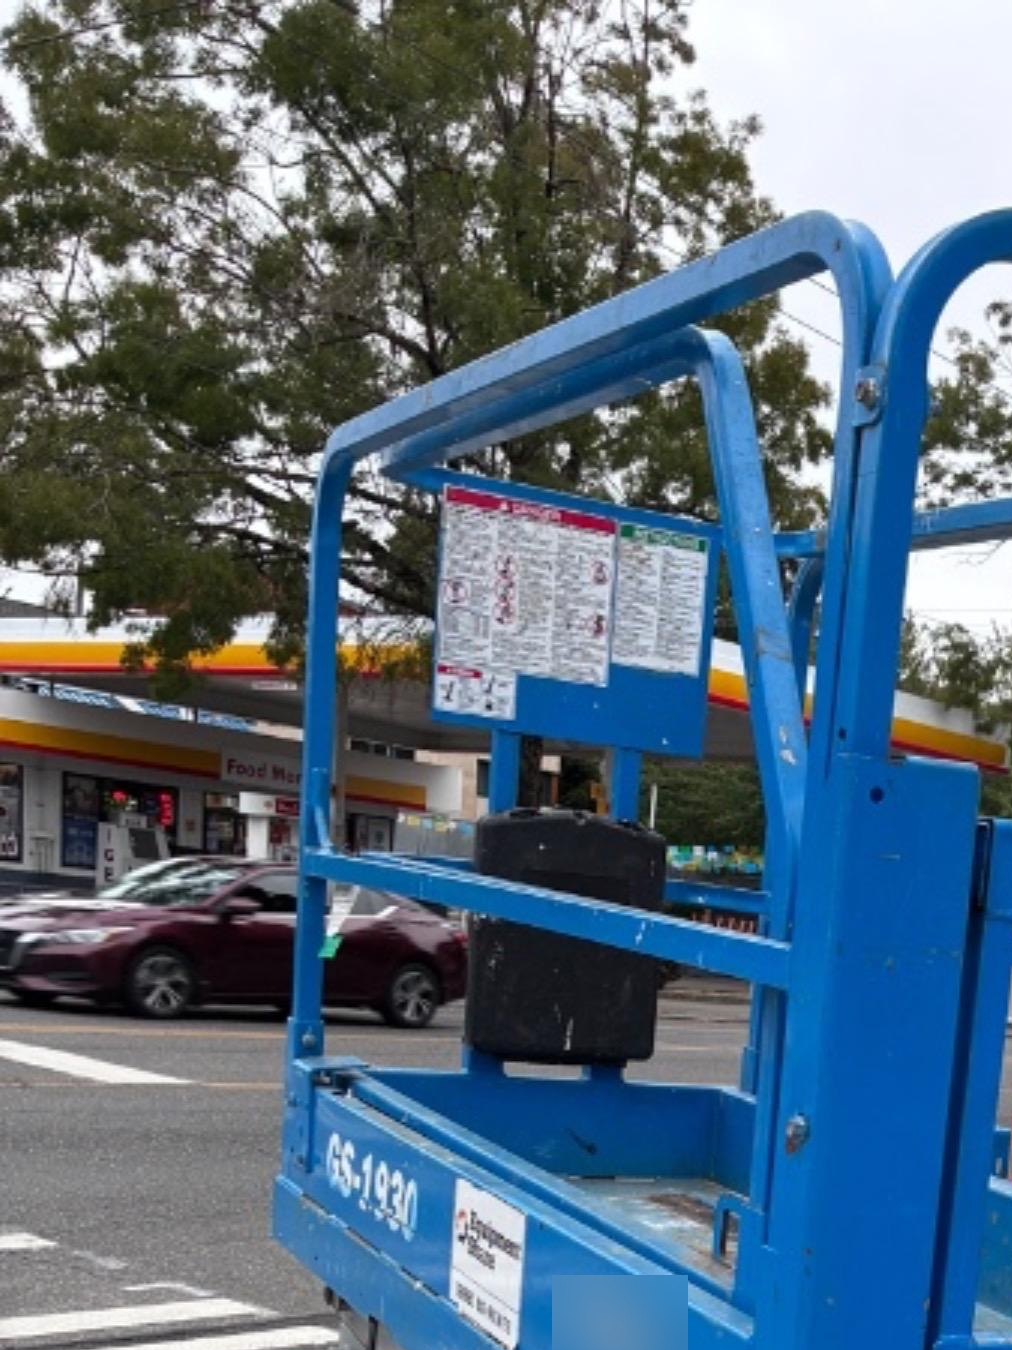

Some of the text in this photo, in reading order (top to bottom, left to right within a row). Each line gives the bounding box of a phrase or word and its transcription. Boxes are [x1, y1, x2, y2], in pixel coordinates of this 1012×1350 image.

[226, 758, 303, 784] Food Mar
[325, 1132, 418, 1242] GS-1930
